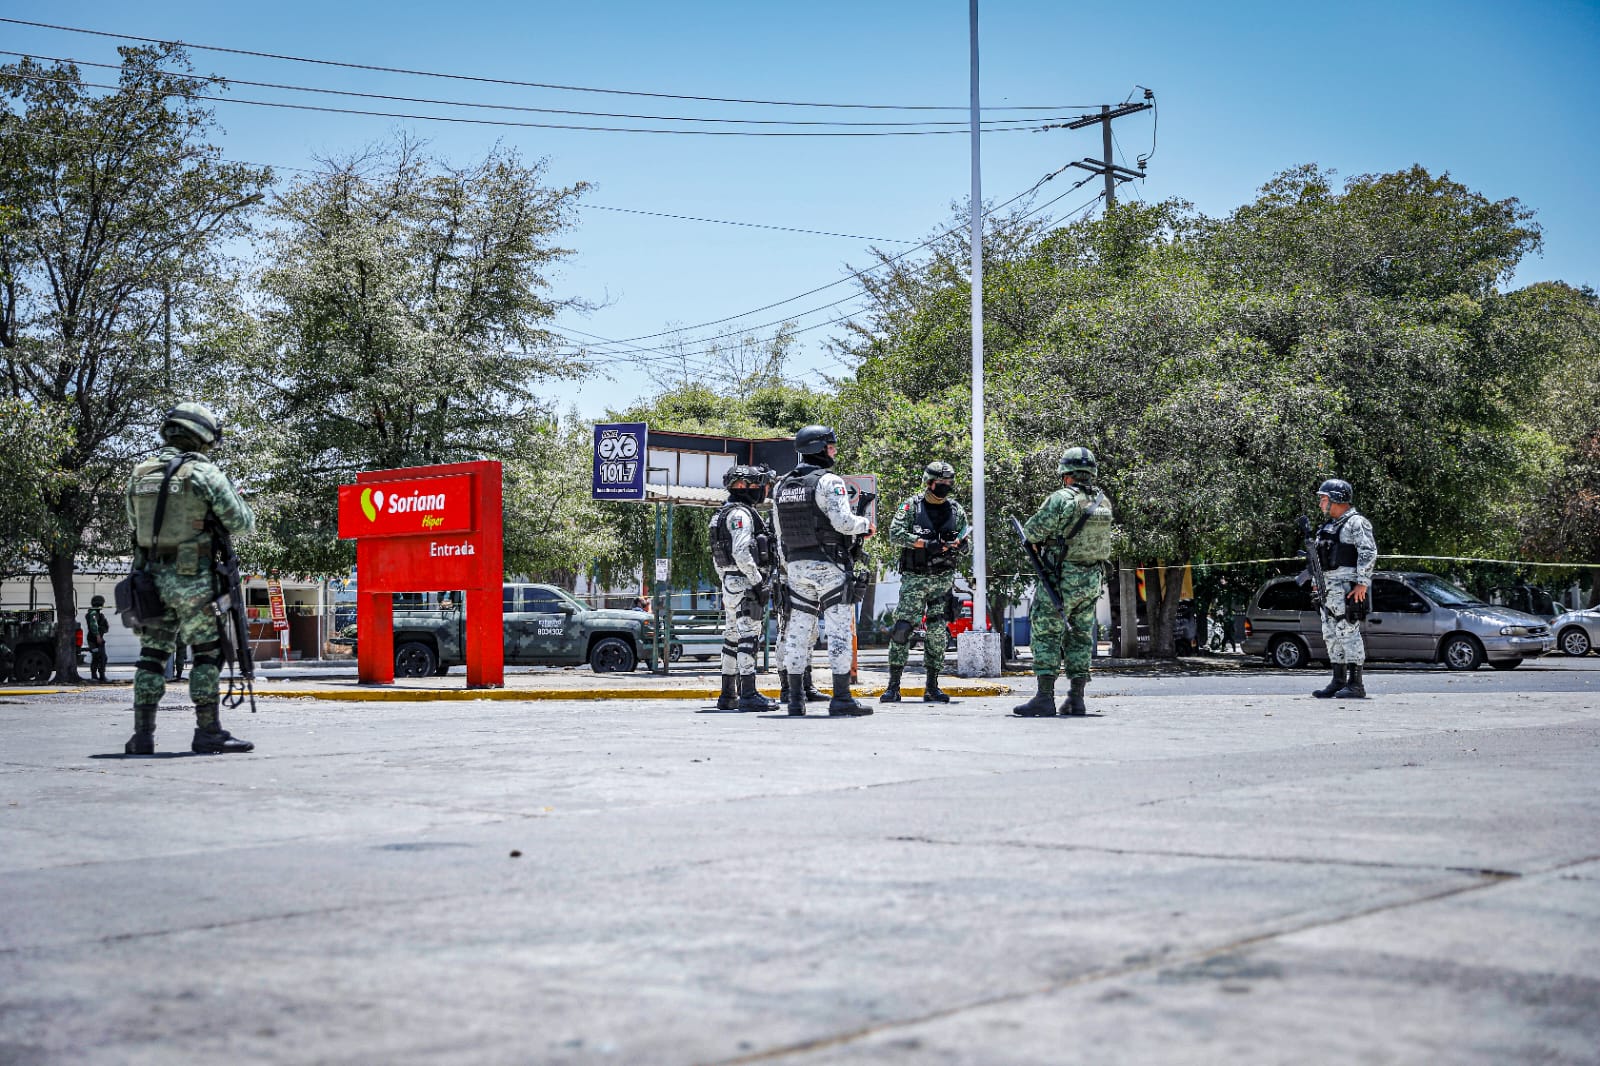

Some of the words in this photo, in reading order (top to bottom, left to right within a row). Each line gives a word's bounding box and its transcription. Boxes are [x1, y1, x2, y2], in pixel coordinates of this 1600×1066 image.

[600, 461, 637, 484] 101.7
[135, 483, 180, 493] EJERCO
[388, 489, 445, 514] Soriana
[421, 514, 444, 530] Hiper
[430, 540, 475, 557] Entrada
